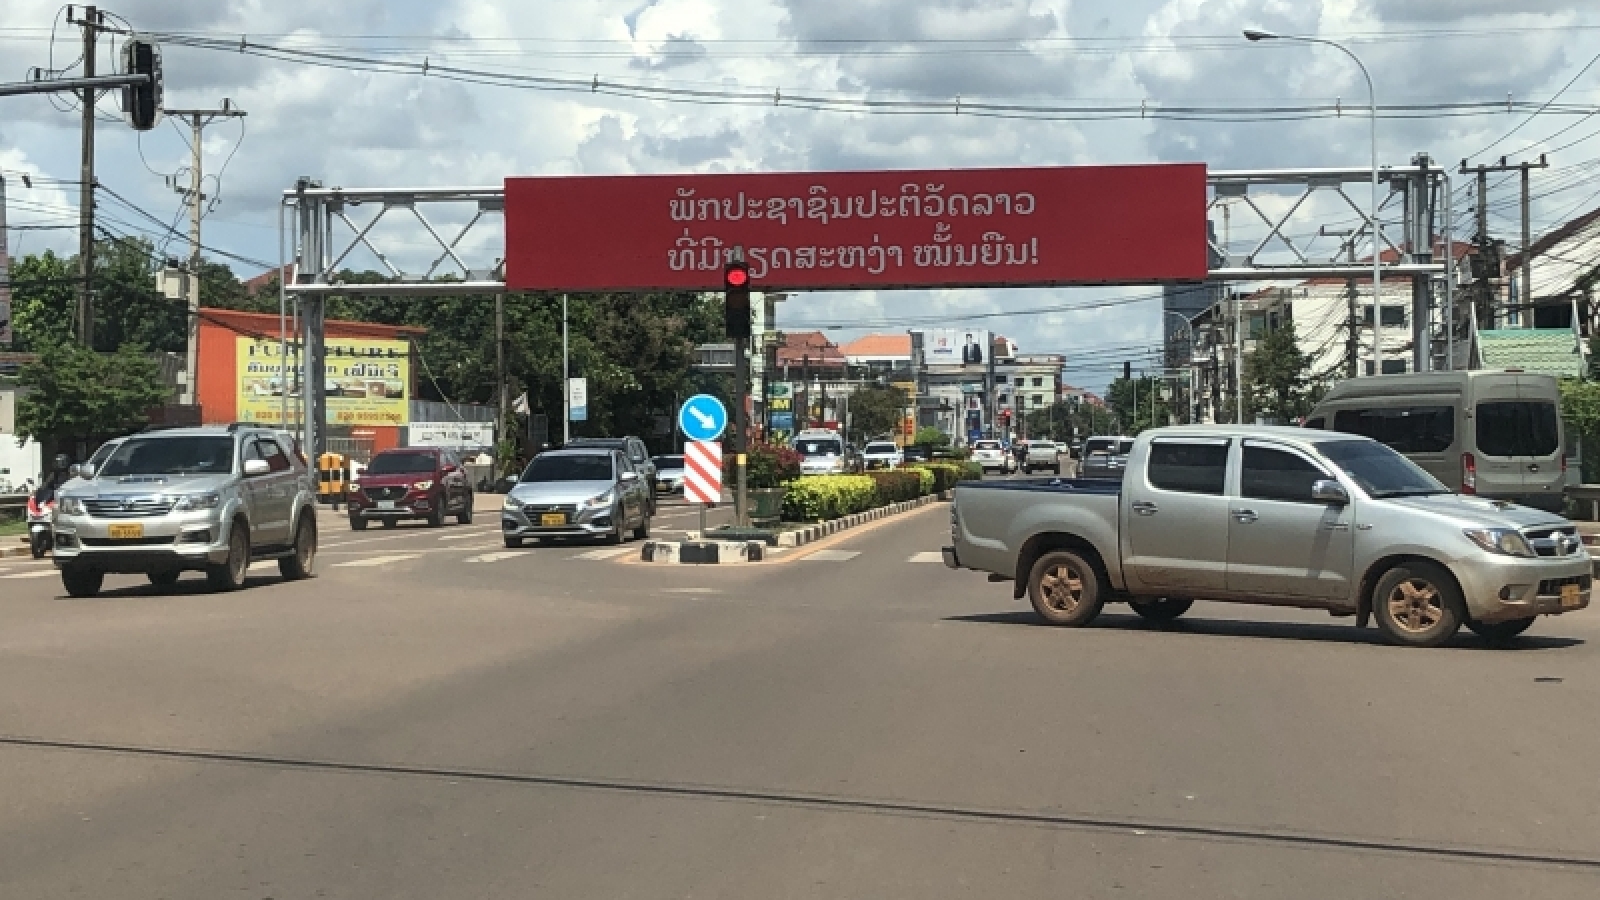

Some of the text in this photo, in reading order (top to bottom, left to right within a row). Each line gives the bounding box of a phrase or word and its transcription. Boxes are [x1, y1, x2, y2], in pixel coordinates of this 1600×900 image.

[669, 183, 1036, 225] ພັກປະຊາຊົນປະຕິວັດລາວ
